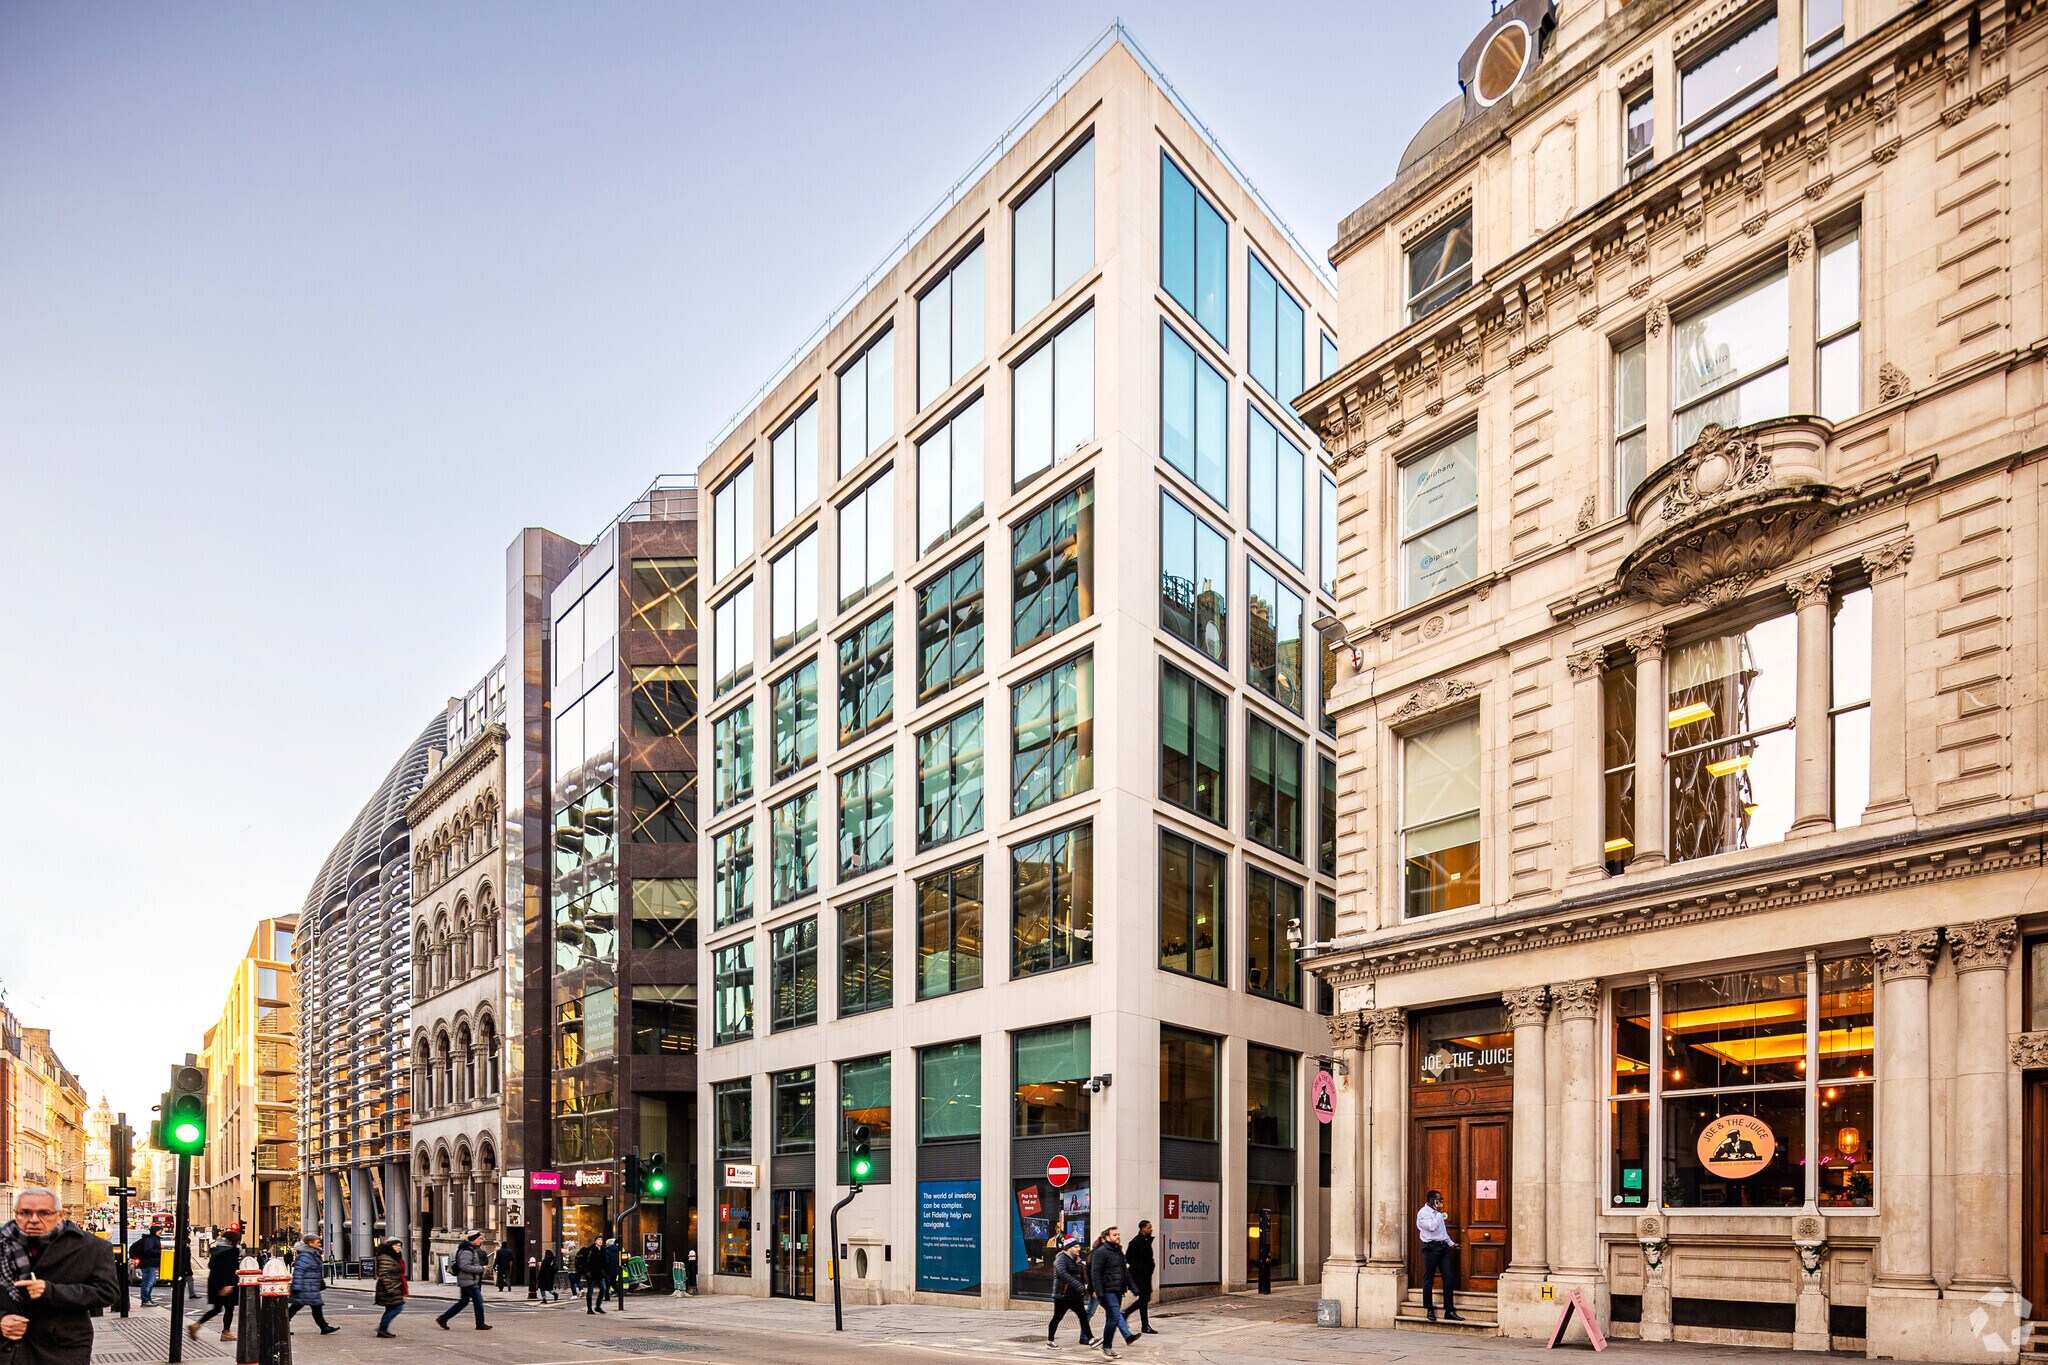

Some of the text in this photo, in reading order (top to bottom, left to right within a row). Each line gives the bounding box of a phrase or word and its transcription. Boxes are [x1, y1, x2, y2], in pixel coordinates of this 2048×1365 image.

[1424, 546, 1458, 565] epiphany
[1421, 1055, 1442, 1071] JOE
[1452, 1051, 1474, 1068] THE
[1477, 1047, 1513, 1066] JUICE
[1703, 1127, 1718, 1142] JOE
[1717, 1122, 1724, 1130] &
[1745, 1121, 1769, 1140] JUICE
[583, 1171, 605, 1185] tossed
[954, 1192, 976, 1200] investing
[941, 1202, 963, 1210] complex.
[1180, 1200, 1210, 1215] Fidelity
[932, 1211, 949, 1220] Fidelity
[950, 1211, 962, 1220] help
[923, 1221, 945, 1229] navigate
[1168, 1238, 1200, 1250] Investor
[1168, 1254, 1196, 1265] Centre
[1541, 1286, 1553, 1299] H
